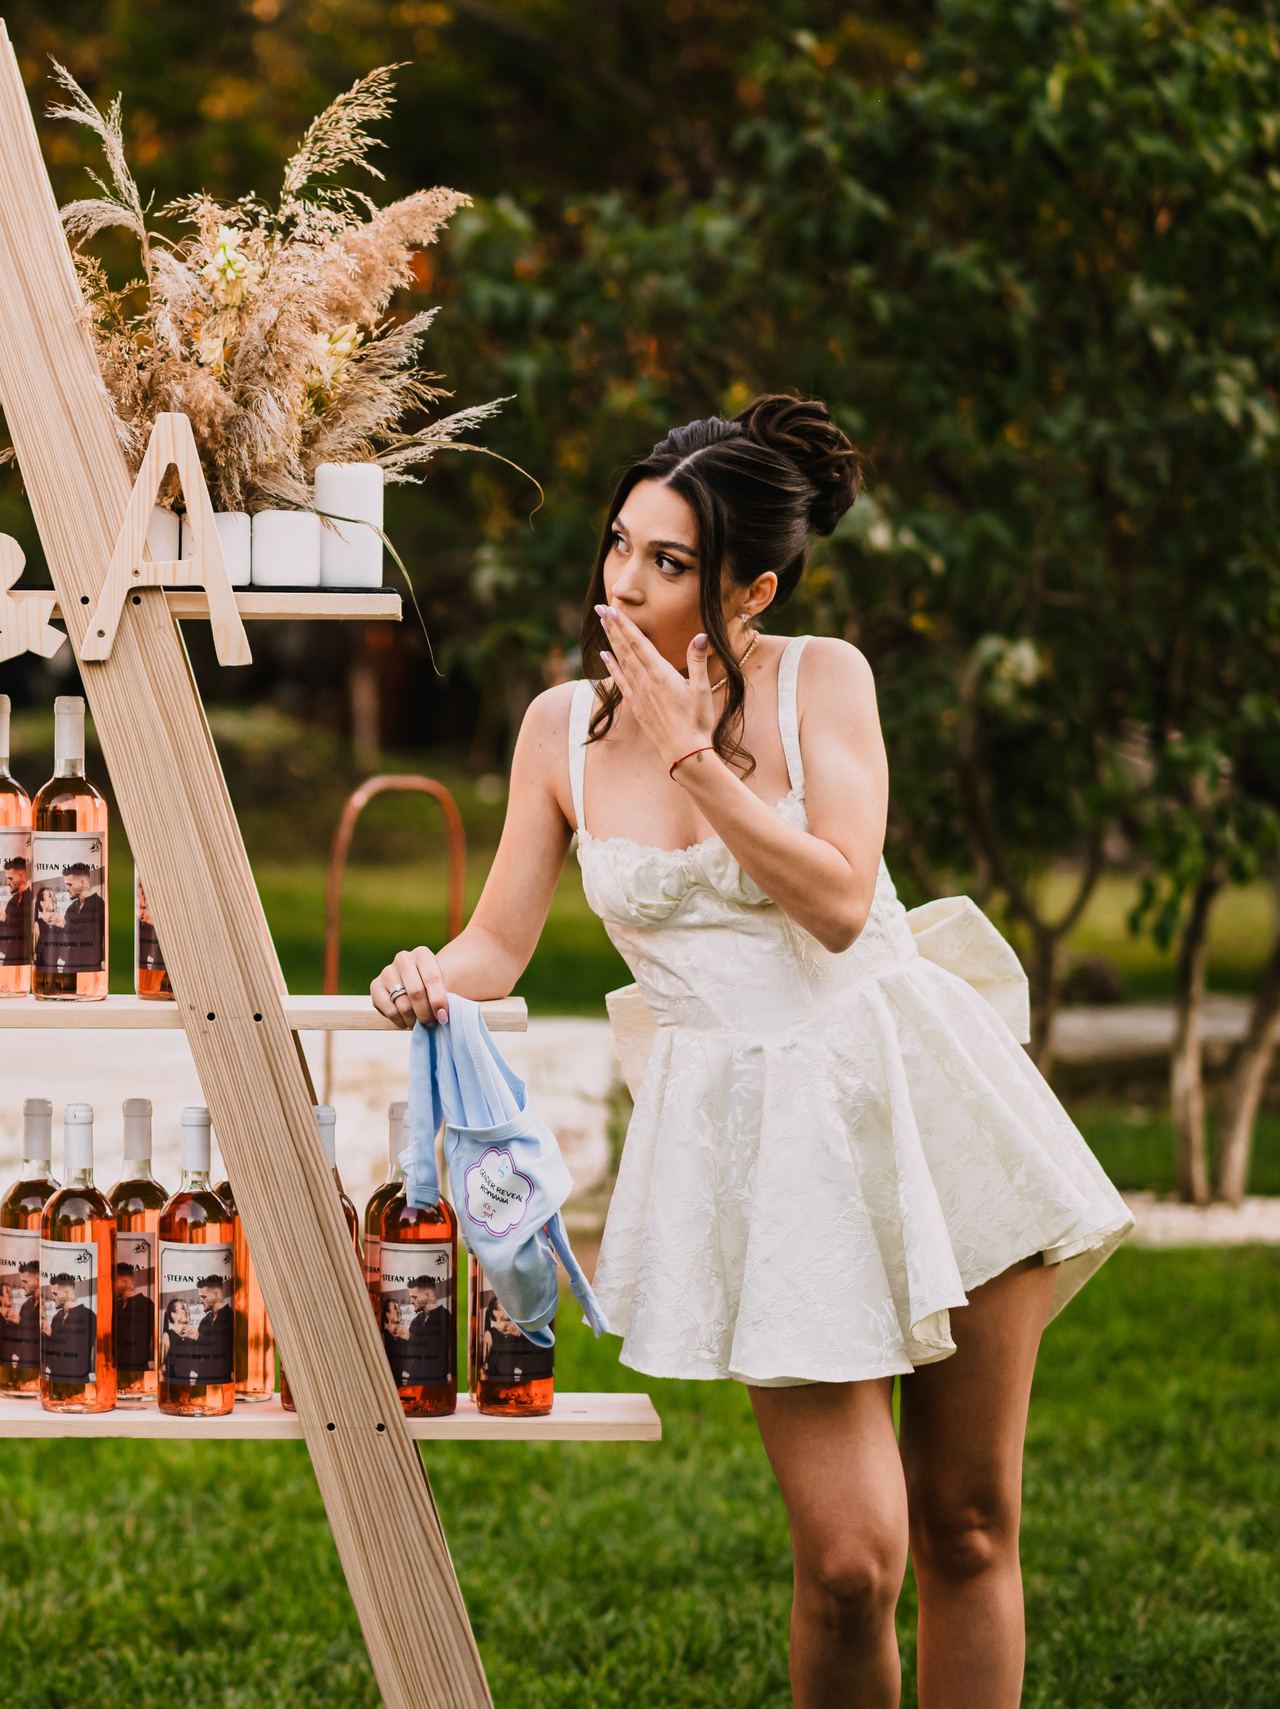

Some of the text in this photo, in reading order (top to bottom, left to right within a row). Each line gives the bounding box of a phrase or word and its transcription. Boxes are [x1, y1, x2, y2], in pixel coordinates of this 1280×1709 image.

[79, 412, 253, 667] A
[479, 1168, 523, 1203] GENDER REVEAL
[480, 1184, 509, 1205] ROMANIA
